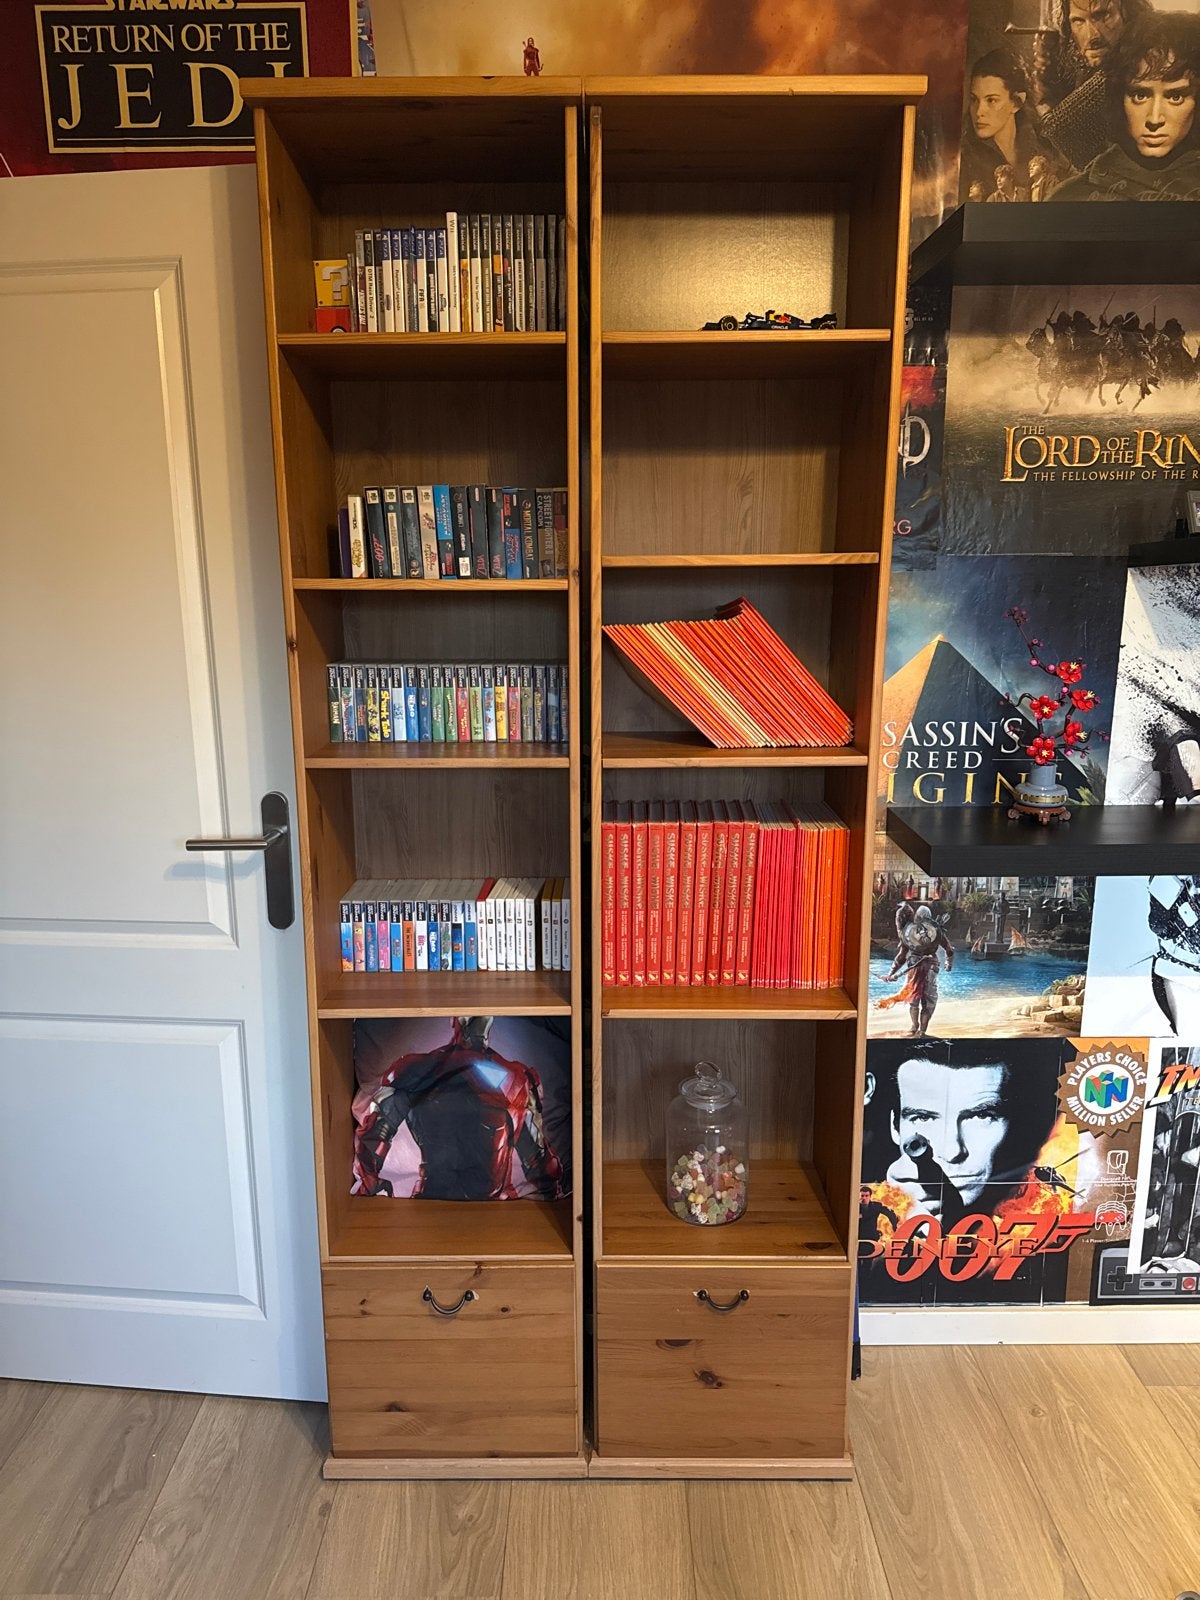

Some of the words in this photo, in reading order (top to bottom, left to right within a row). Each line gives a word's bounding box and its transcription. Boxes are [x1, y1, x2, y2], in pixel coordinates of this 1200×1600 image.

[51, 24, 175, 53] RETURN
[181, 23, 223, 52] OF
[227, 22, 292, 51] THE
[57, 62, 292, 130] JED
[1022, 426, 1044, 435] THE
[1000, 426, 1100, 482] LORD
[1106, 438, 1129, 450] OF
[1100, 451, 1134, 464] THE
[1033, 472, 1055, 481] THE
[1062, 471, 1135, 481] FELLOWSHIP
[1141, 471, 1157, 480] OF
[1163, 470, 1186, 479] THE
[544, 495, 552, 520] STREET
[523, 511, 531, 534] MORTAL
[525, 536, 533, 561] KOMBAT
[380, 690, 390, 718] Shark
[381, 720, 391, 738] Tale
[882, 751, 983, 769] CREED
[1066, 1051, 1111, 1086] PLAYERS
[1115, 1053, 1147, 1086] CHOICE
[1066, 1095, 1106, 1126] MILLION
[1109, 1096, 1145, 1125] SELLER
[885, 1213, 1092, 1282] 007
